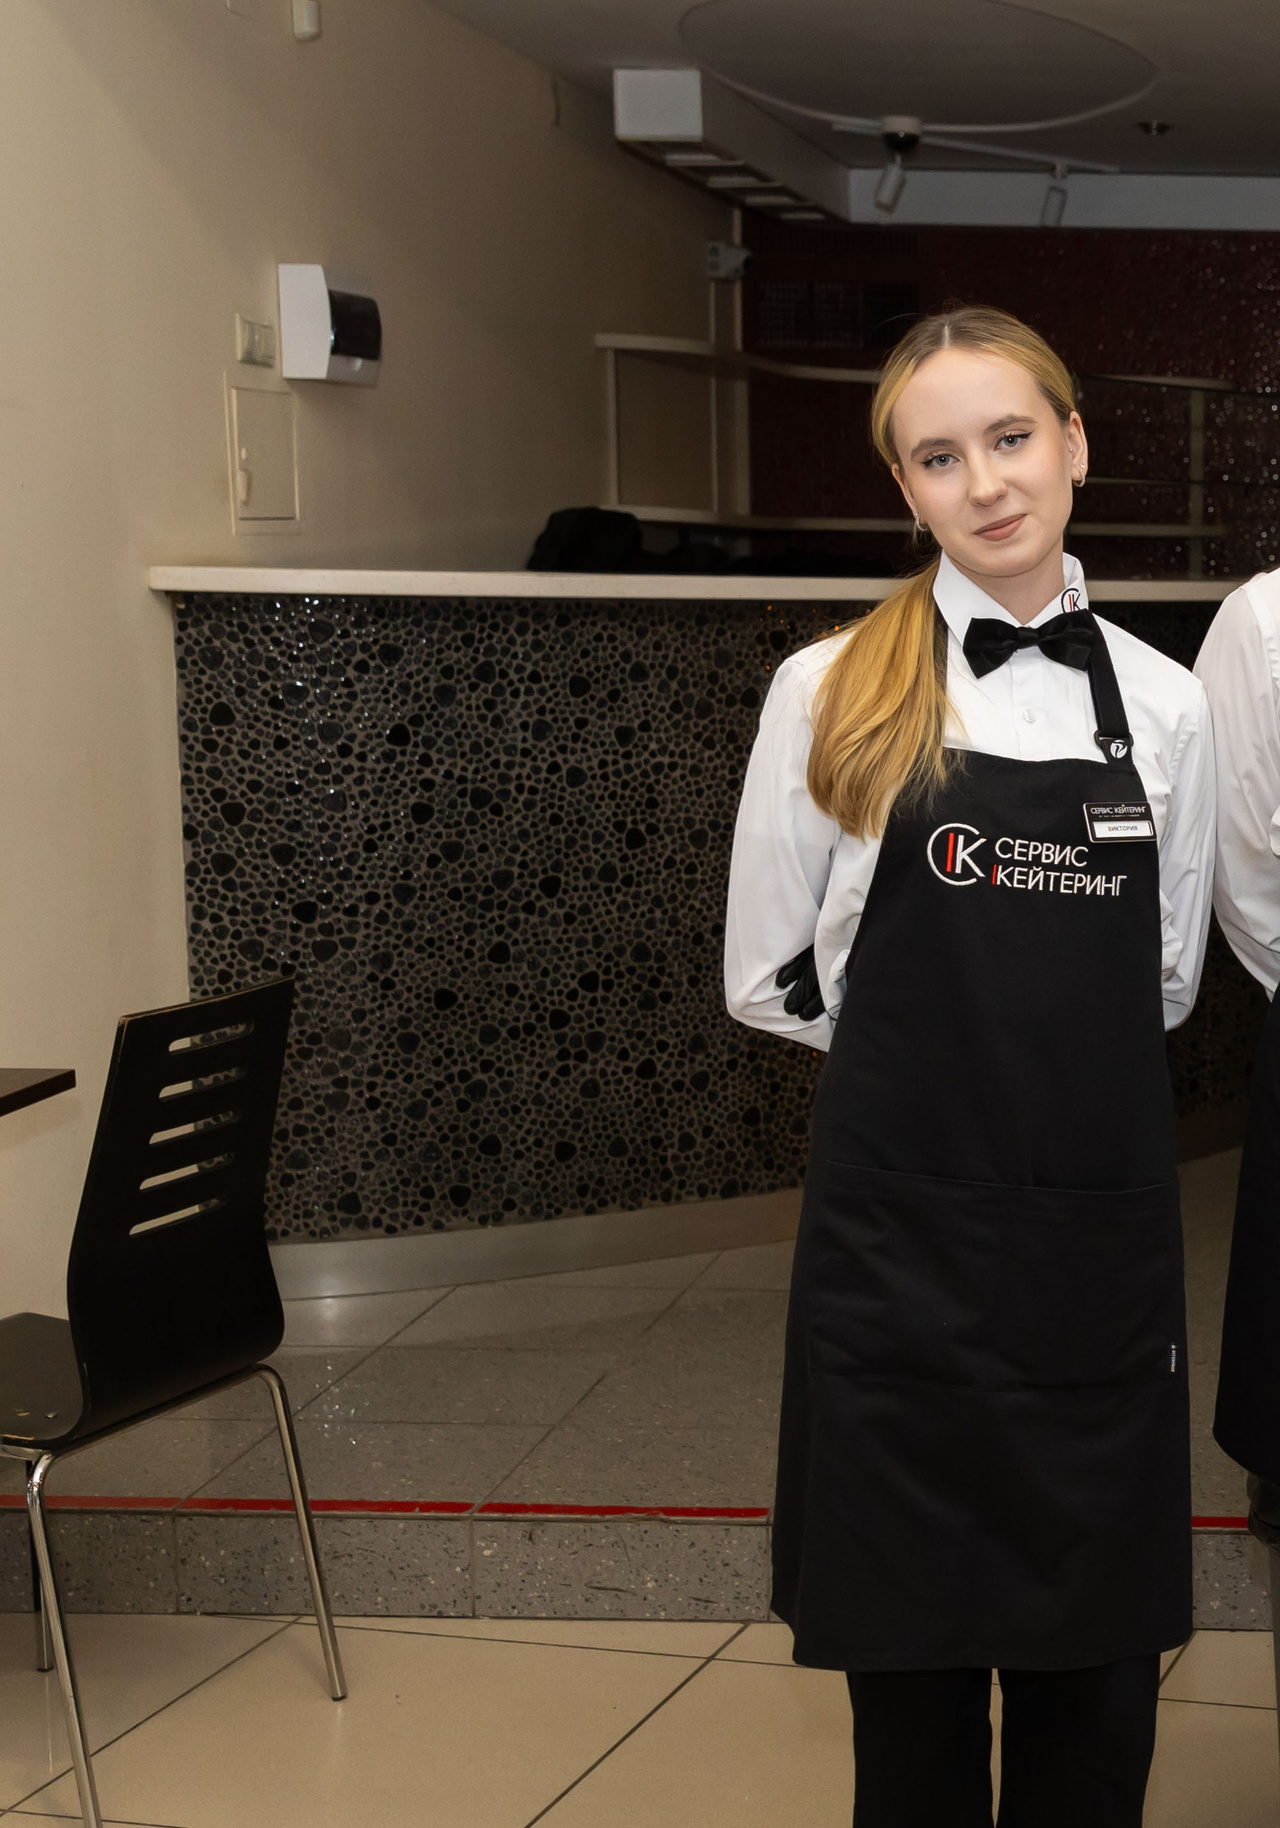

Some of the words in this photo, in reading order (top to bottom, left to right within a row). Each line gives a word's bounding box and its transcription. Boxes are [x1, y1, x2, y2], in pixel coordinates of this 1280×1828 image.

[1090, 806, 1114, 815] СЕРВИС
[1115, 804, 1147, 814] КЕЙТЕРИНГ
[995, 837, 1089, 867] СЕРВИС
[995, 865, 1128, 896] КЕЙТЕРИНГ
